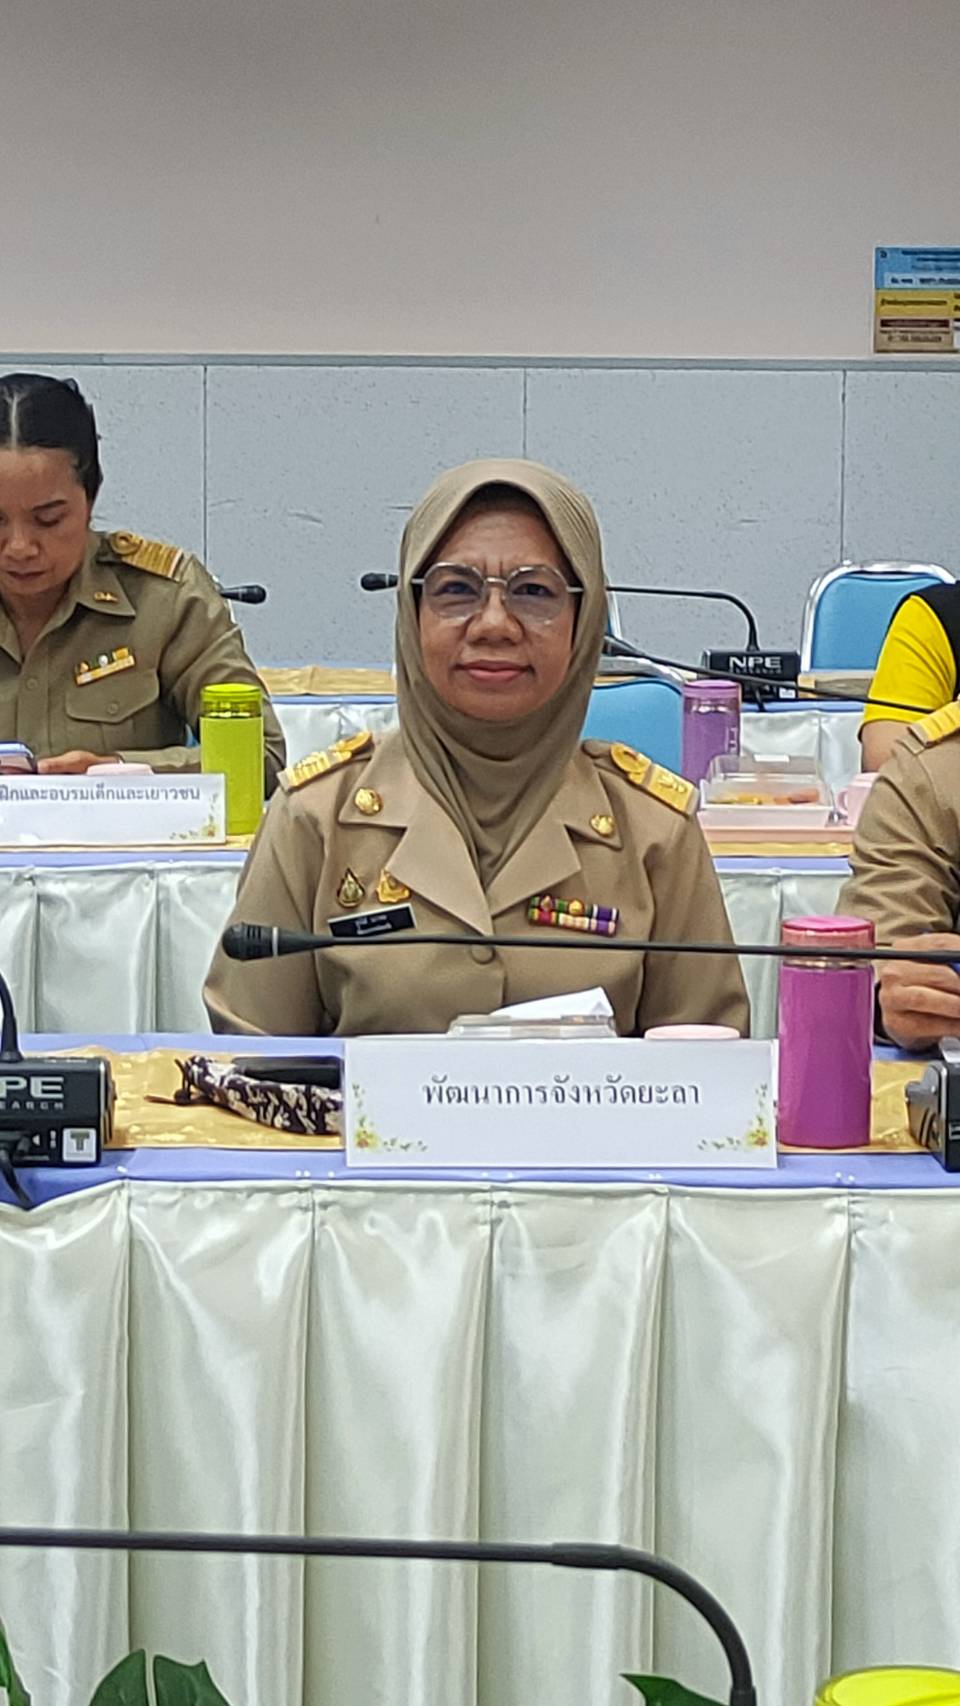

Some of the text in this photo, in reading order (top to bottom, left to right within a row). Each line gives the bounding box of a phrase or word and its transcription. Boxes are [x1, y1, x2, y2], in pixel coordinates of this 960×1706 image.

[729, 656, 781, 668] NPE
[422, 1074, 699, 1104] พัฒนาการจังหวัดยะลา
